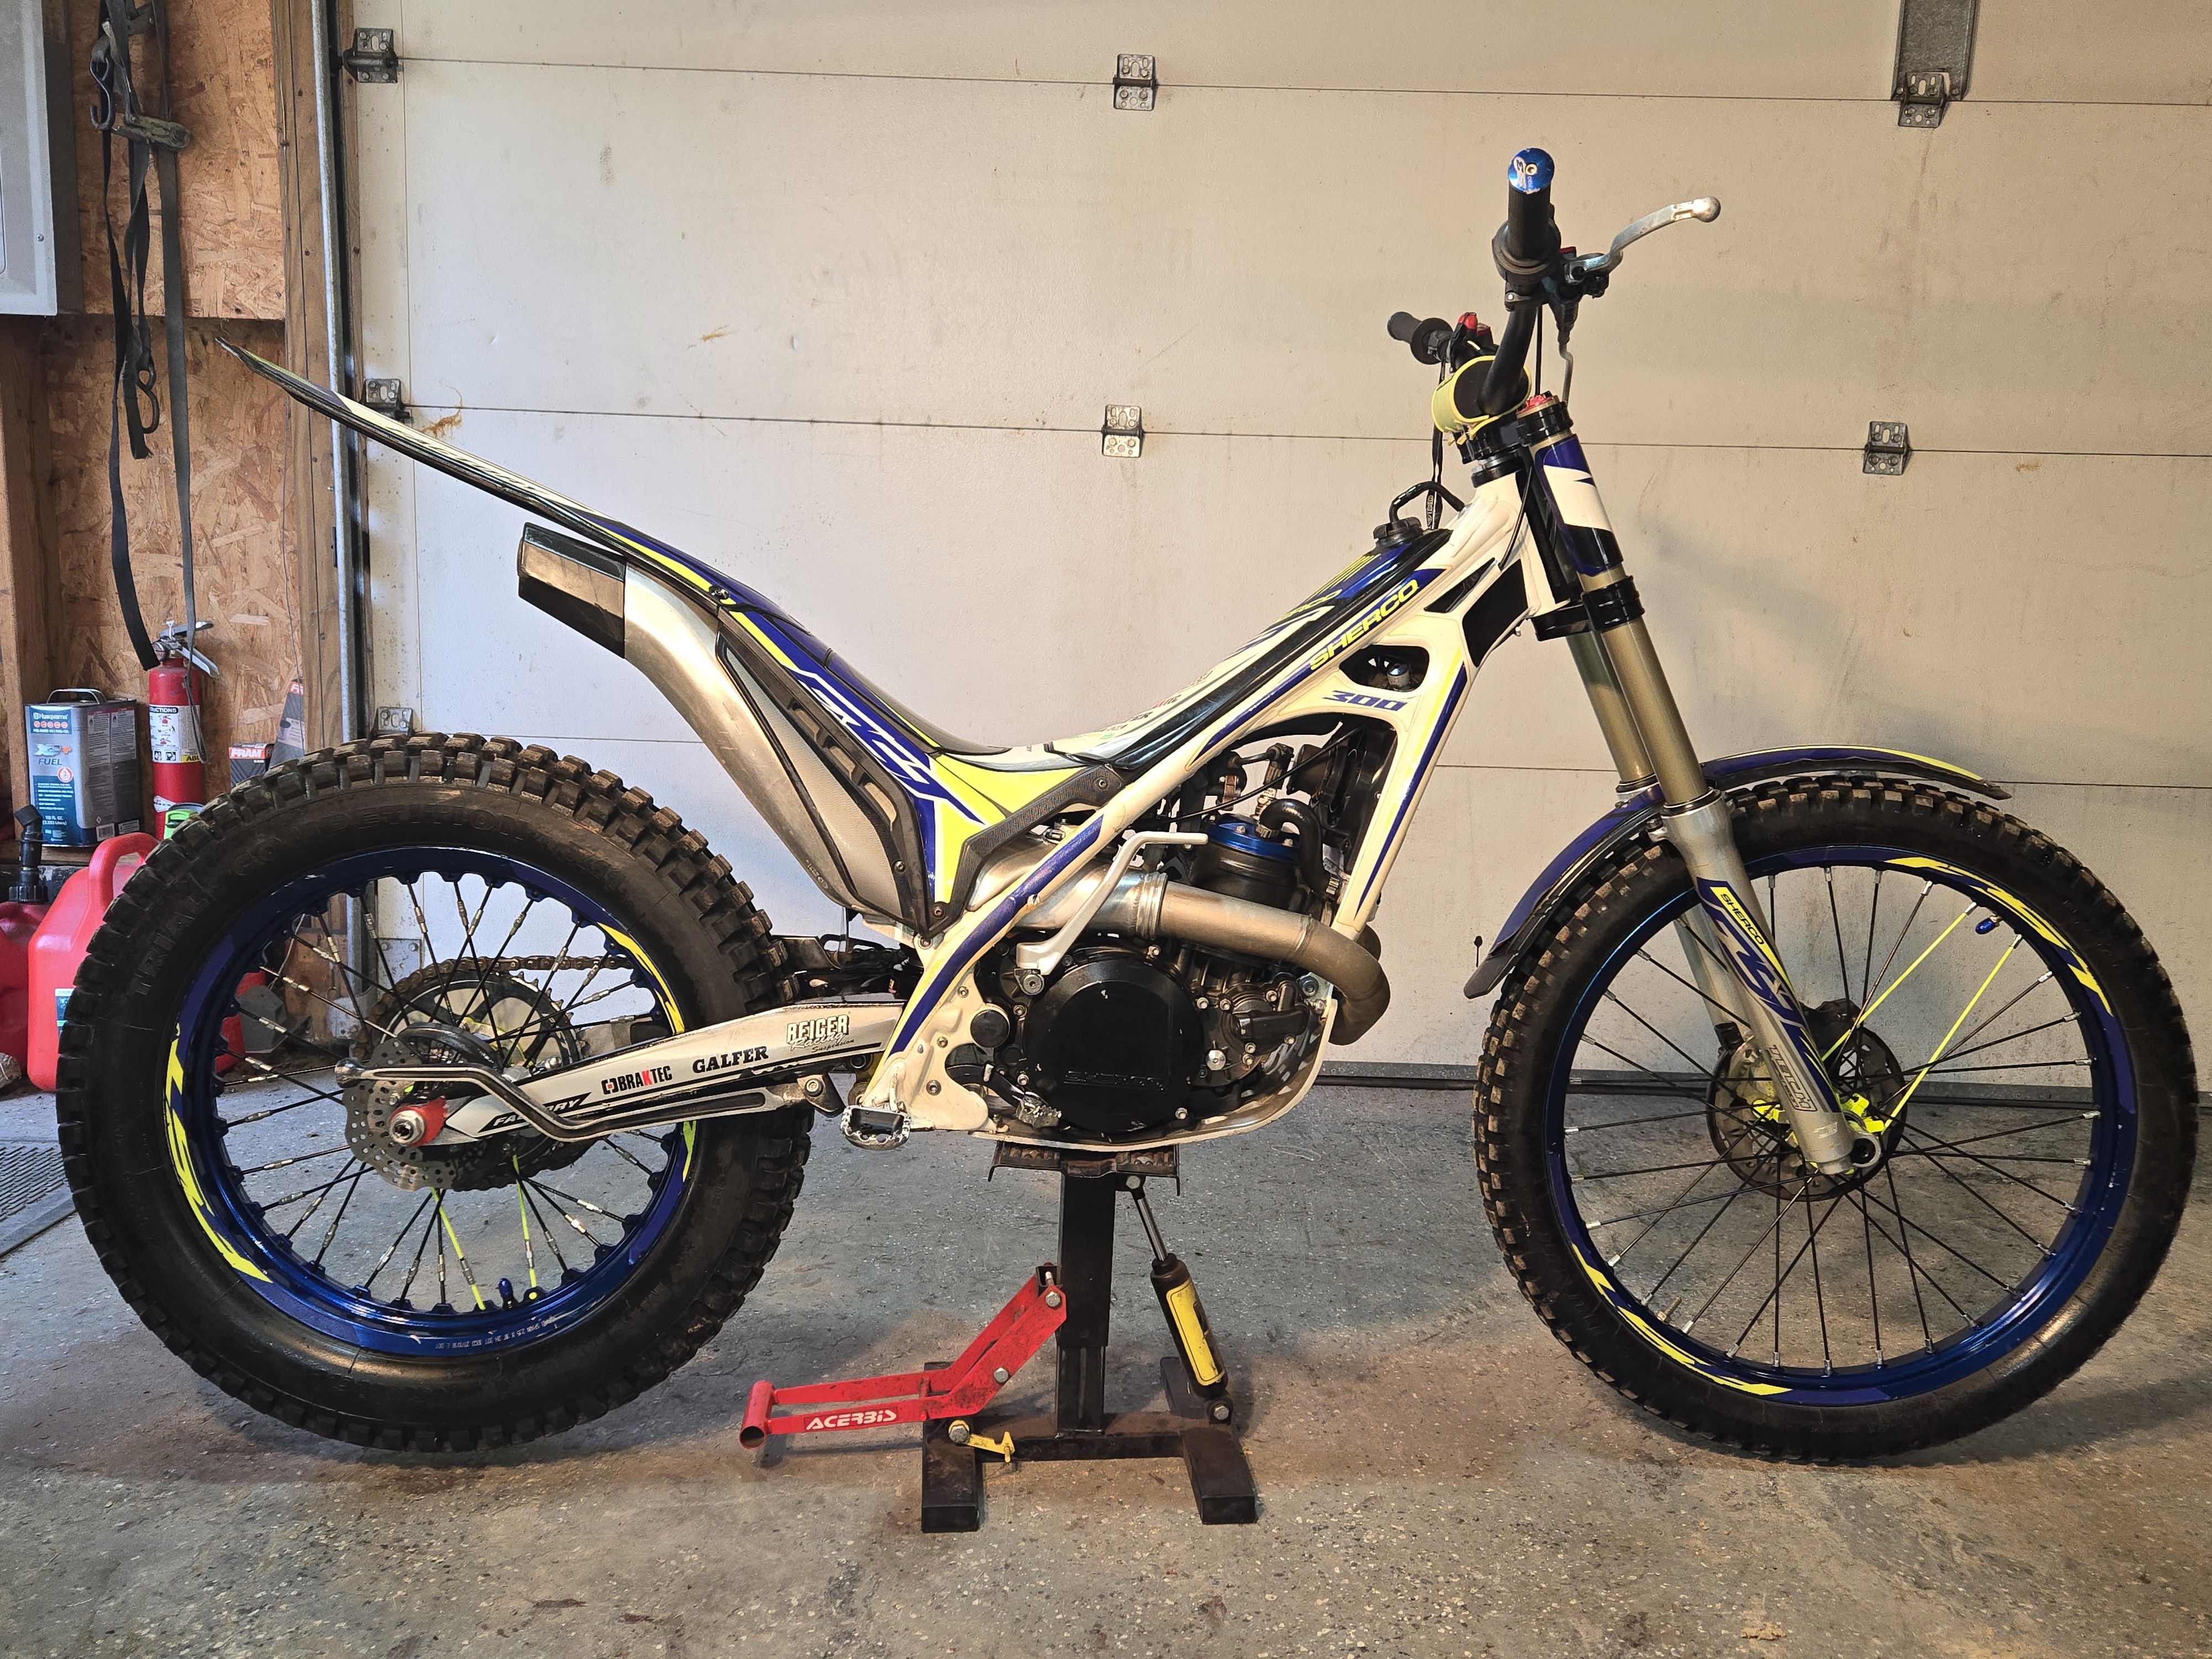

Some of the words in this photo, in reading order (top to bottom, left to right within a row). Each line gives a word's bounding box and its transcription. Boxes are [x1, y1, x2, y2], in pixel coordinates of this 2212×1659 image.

[1310, 579, 1418, 671] SHERCO
[1322, 690, 1408, 712] 300
[231, 748, 262, 758] FRAM
[1720, 894, 1765, 945] SHERCO
[786, 1014, 850, 1045] REIGER
[789, 1031, 845, 1052] Racing
[692, 1045, 769, 1074] GALFER
[811, 1039, 855, 1053] Suspension
[1768, 1044, 1812, 1109] TECH
[493, 1098, 581, 1127] FARY
